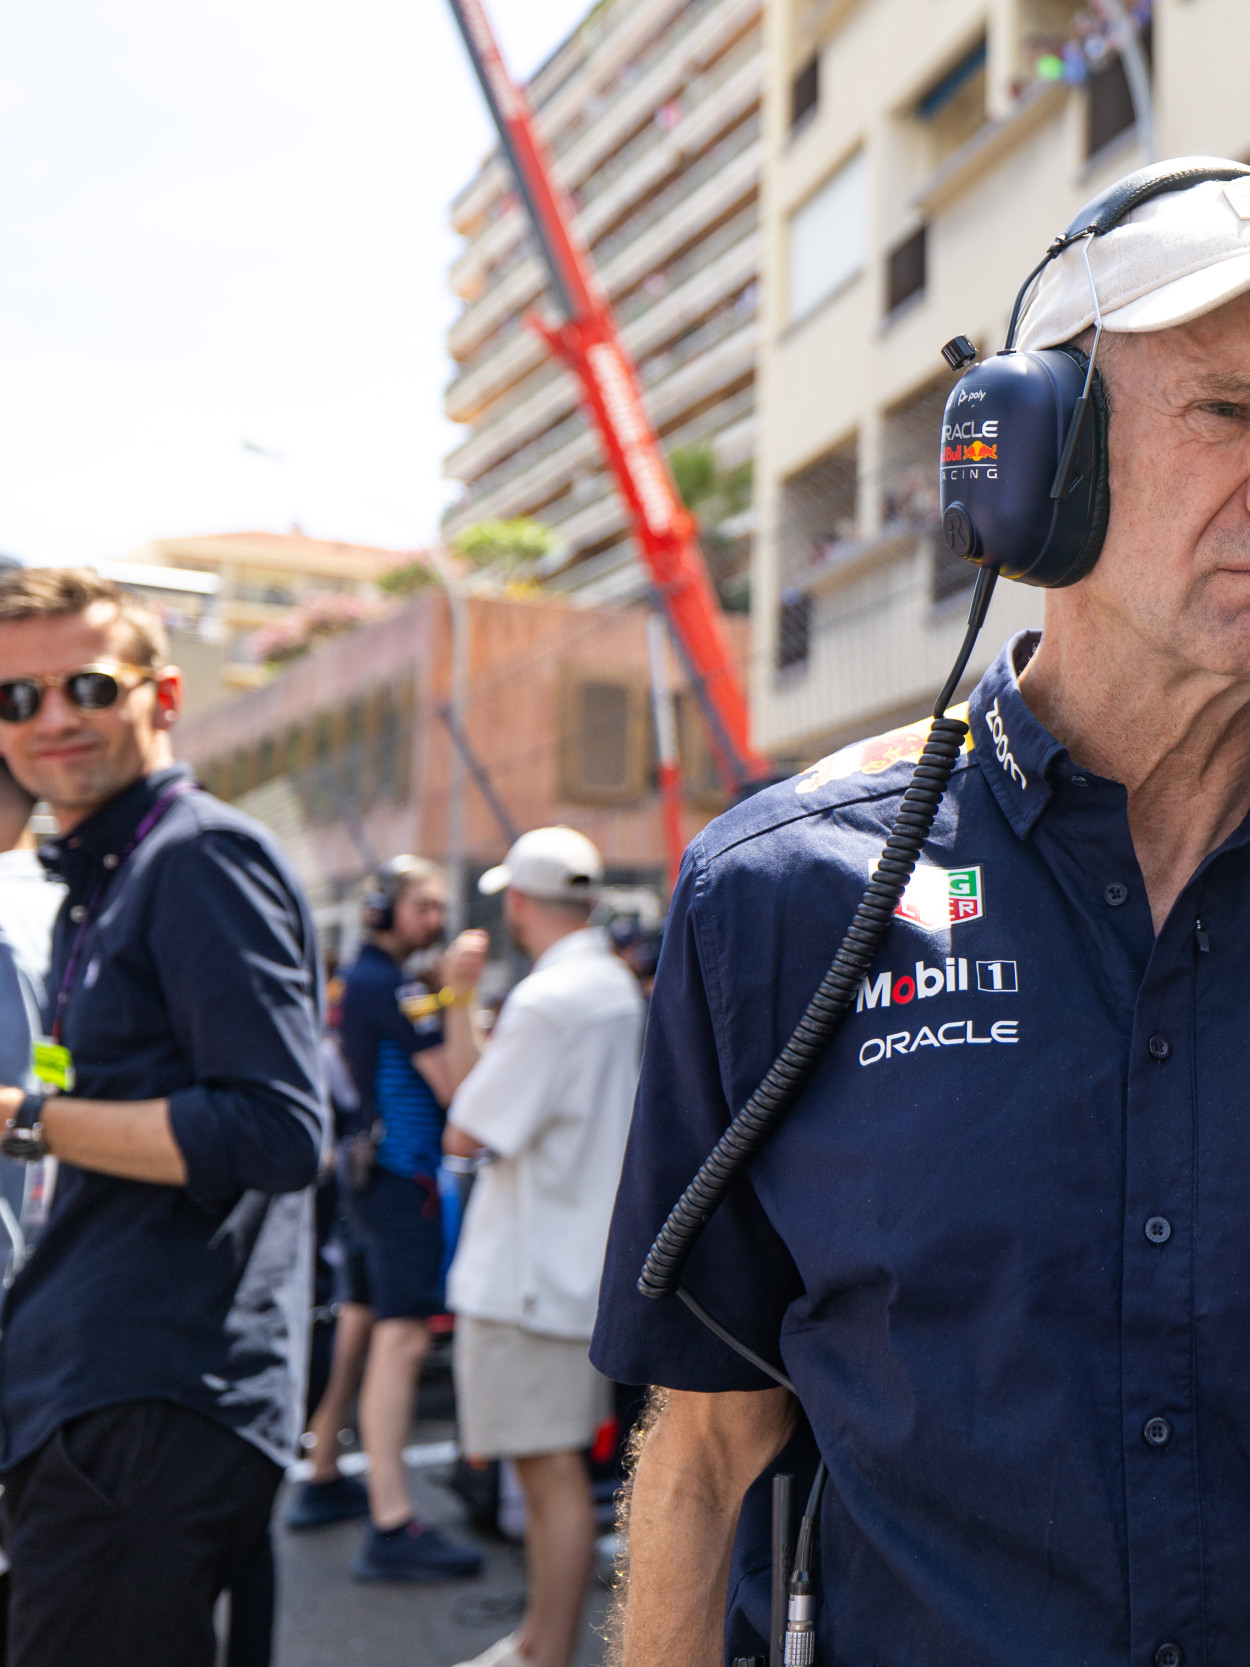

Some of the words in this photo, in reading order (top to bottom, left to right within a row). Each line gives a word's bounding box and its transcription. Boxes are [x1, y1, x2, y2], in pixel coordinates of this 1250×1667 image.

[968, 389, 986, 402] poly
[942, 420, 999, 441] RACLE
[941, 468, 998, 481] ACING
[856, 957, 968, 1013] Mobil
[988, 963, 1002, 990] 1
[859, 1020, 1020, 1067] ORACLE
